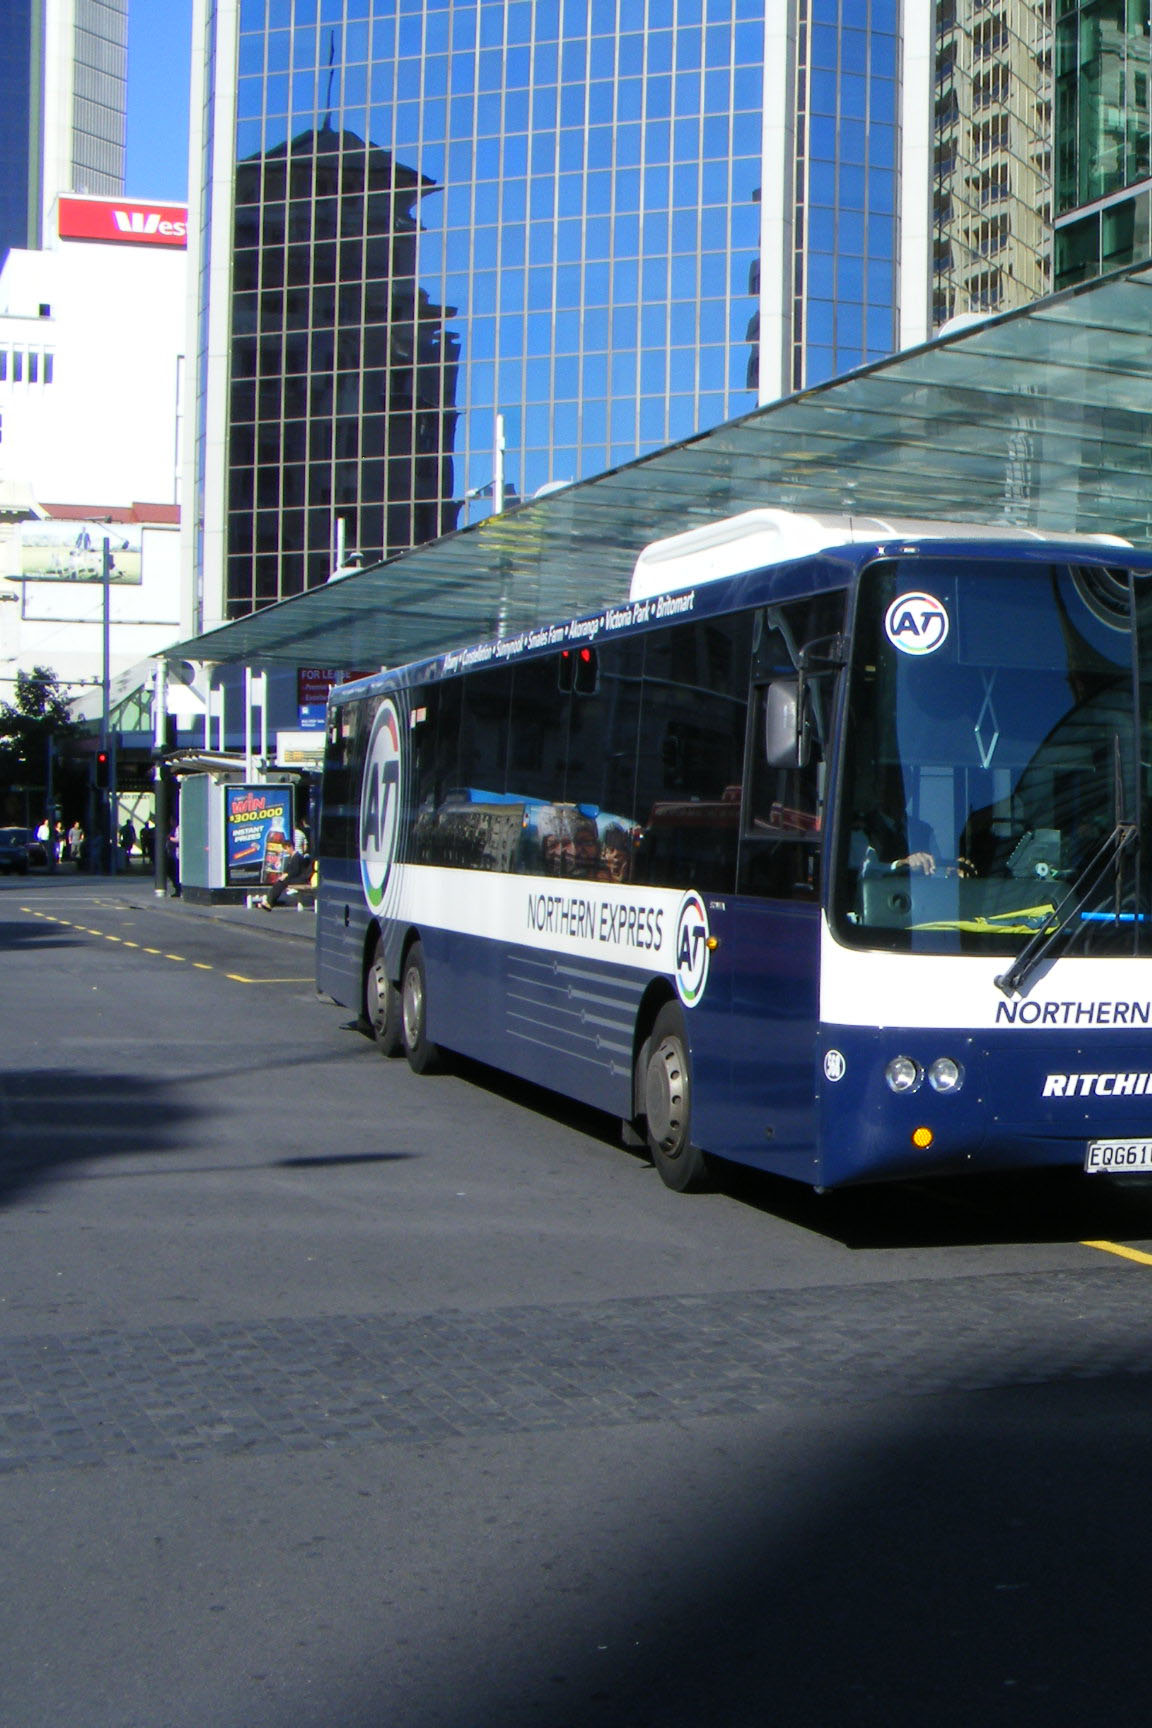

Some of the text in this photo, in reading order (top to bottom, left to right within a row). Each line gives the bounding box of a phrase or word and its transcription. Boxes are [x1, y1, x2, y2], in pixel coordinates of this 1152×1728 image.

[112, 210, 187, 236] Wes
[605, 605, 632, 630] Victoria
[632, 599, 651, 624] Park
[655, 590, 695, 618] Britomart
[891, 611, 943, 636] AT
[361, 759, 400, 852] AT
[528, 894, 664, 951] NORTHERN EXPRESS
[677, 924, 707, 972] AT
[995, 1001, 1150, 1024] NORTHERN
